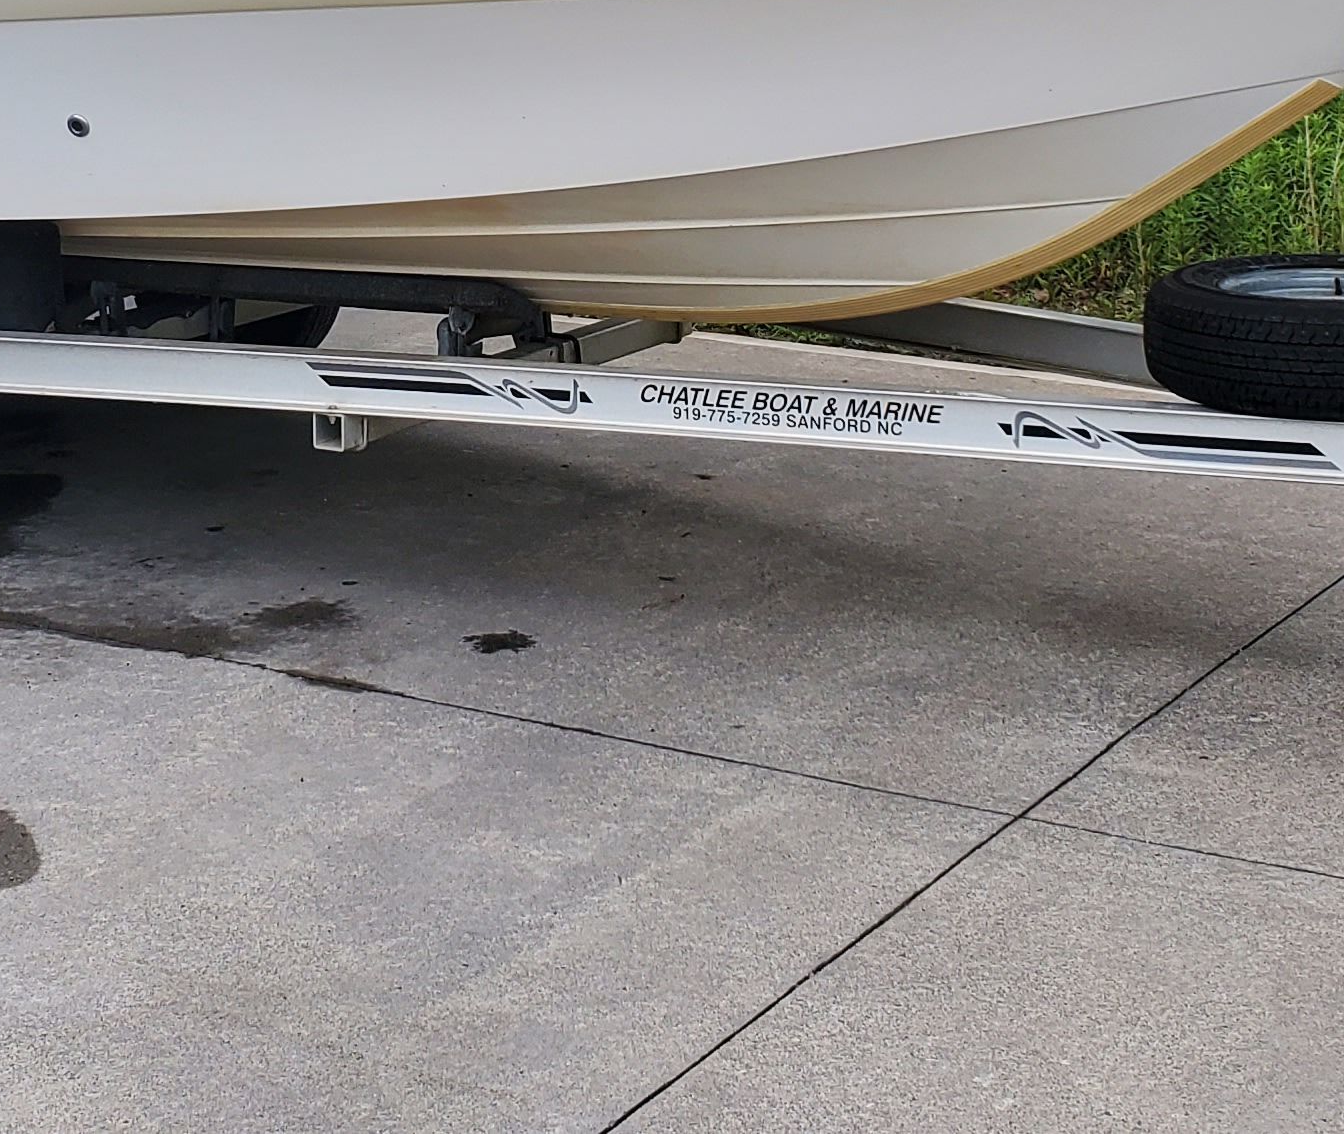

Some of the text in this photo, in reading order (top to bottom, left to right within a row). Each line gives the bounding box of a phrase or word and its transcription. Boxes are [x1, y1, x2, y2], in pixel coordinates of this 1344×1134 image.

[640, 384, 944, 424] CHATLEE BOAT & MARINE
[672, 406, 903, 436] 919-775-7259 SANFORD NC
